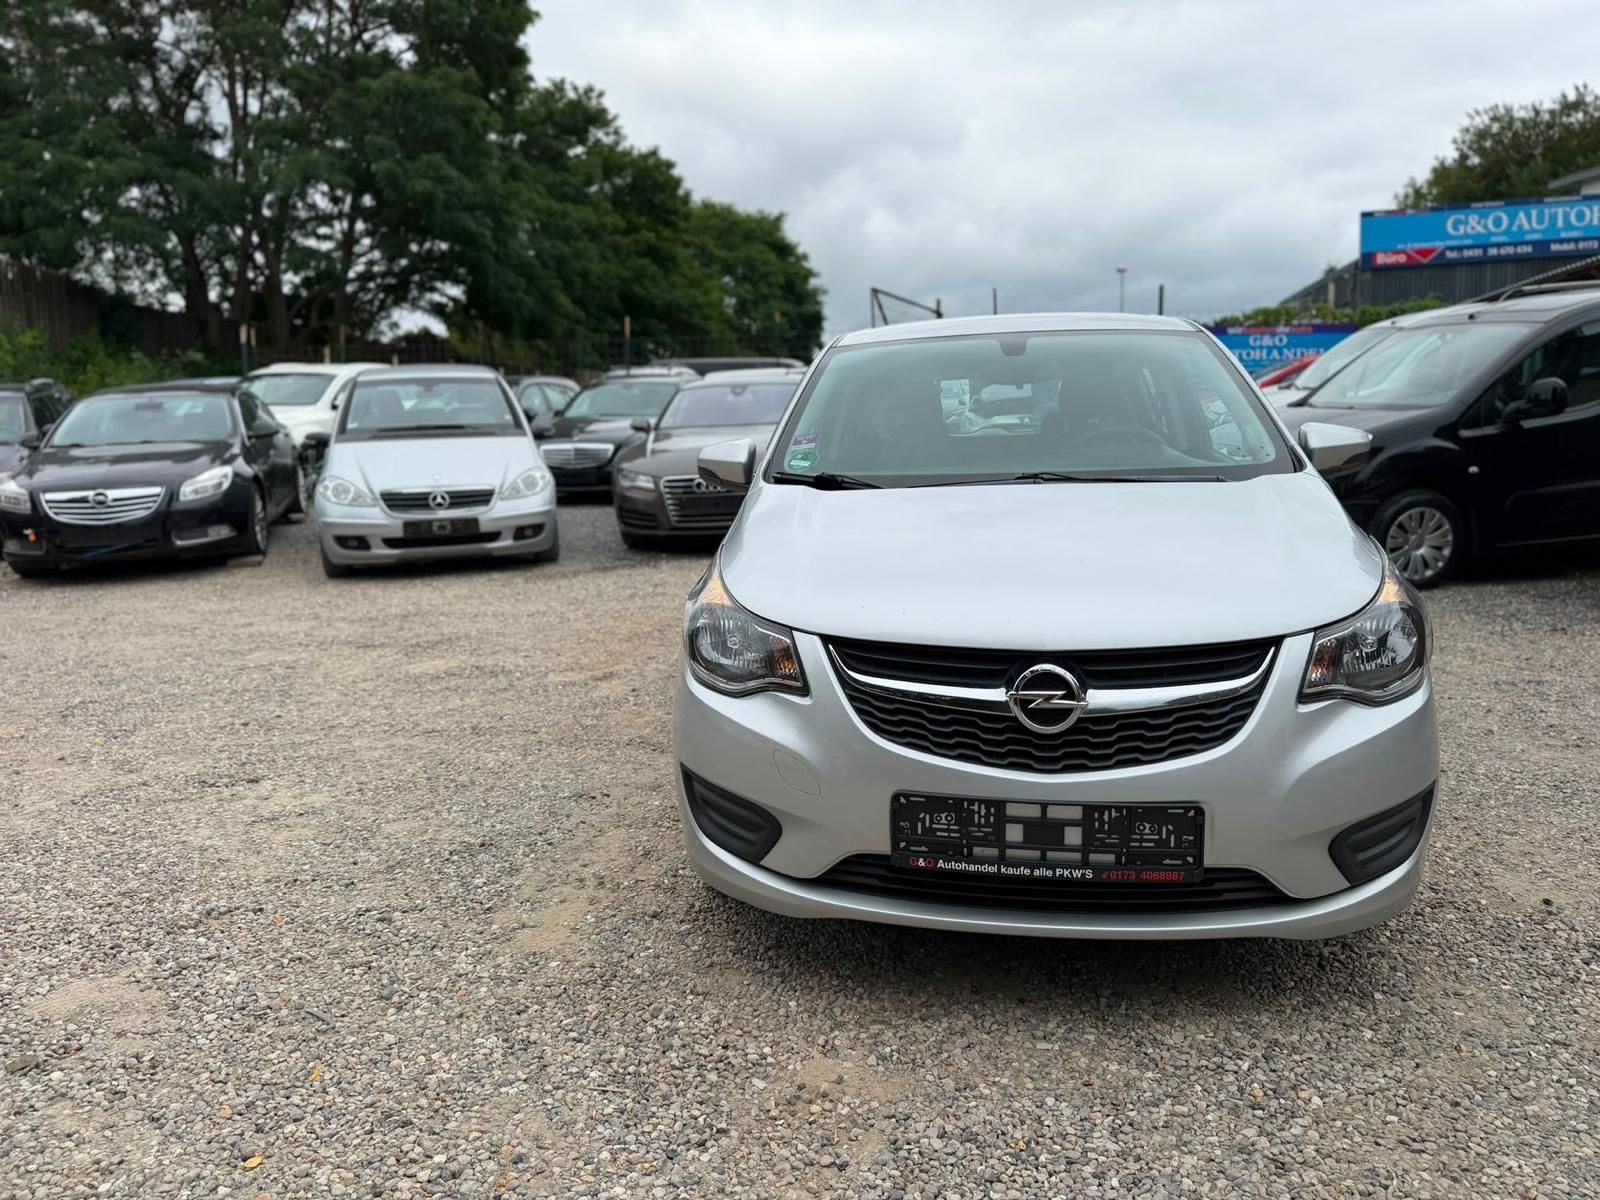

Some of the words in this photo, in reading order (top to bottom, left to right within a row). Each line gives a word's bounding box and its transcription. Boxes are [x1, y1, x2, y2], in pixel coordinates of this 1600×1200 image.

[1446, 211, 1509, 236] G&O
[1249, 334, 1288, 347] G&O
[909, 856, 934, 869] G&O
[936, 859, 998, 874] Autohandel
[1000, 865, 1031, 876] kaufe
[1033, 867, 1053, 878] alle
[1055, 868, 1094, 880] PKW'S
[1110, 870, 1136, 881] 0173
